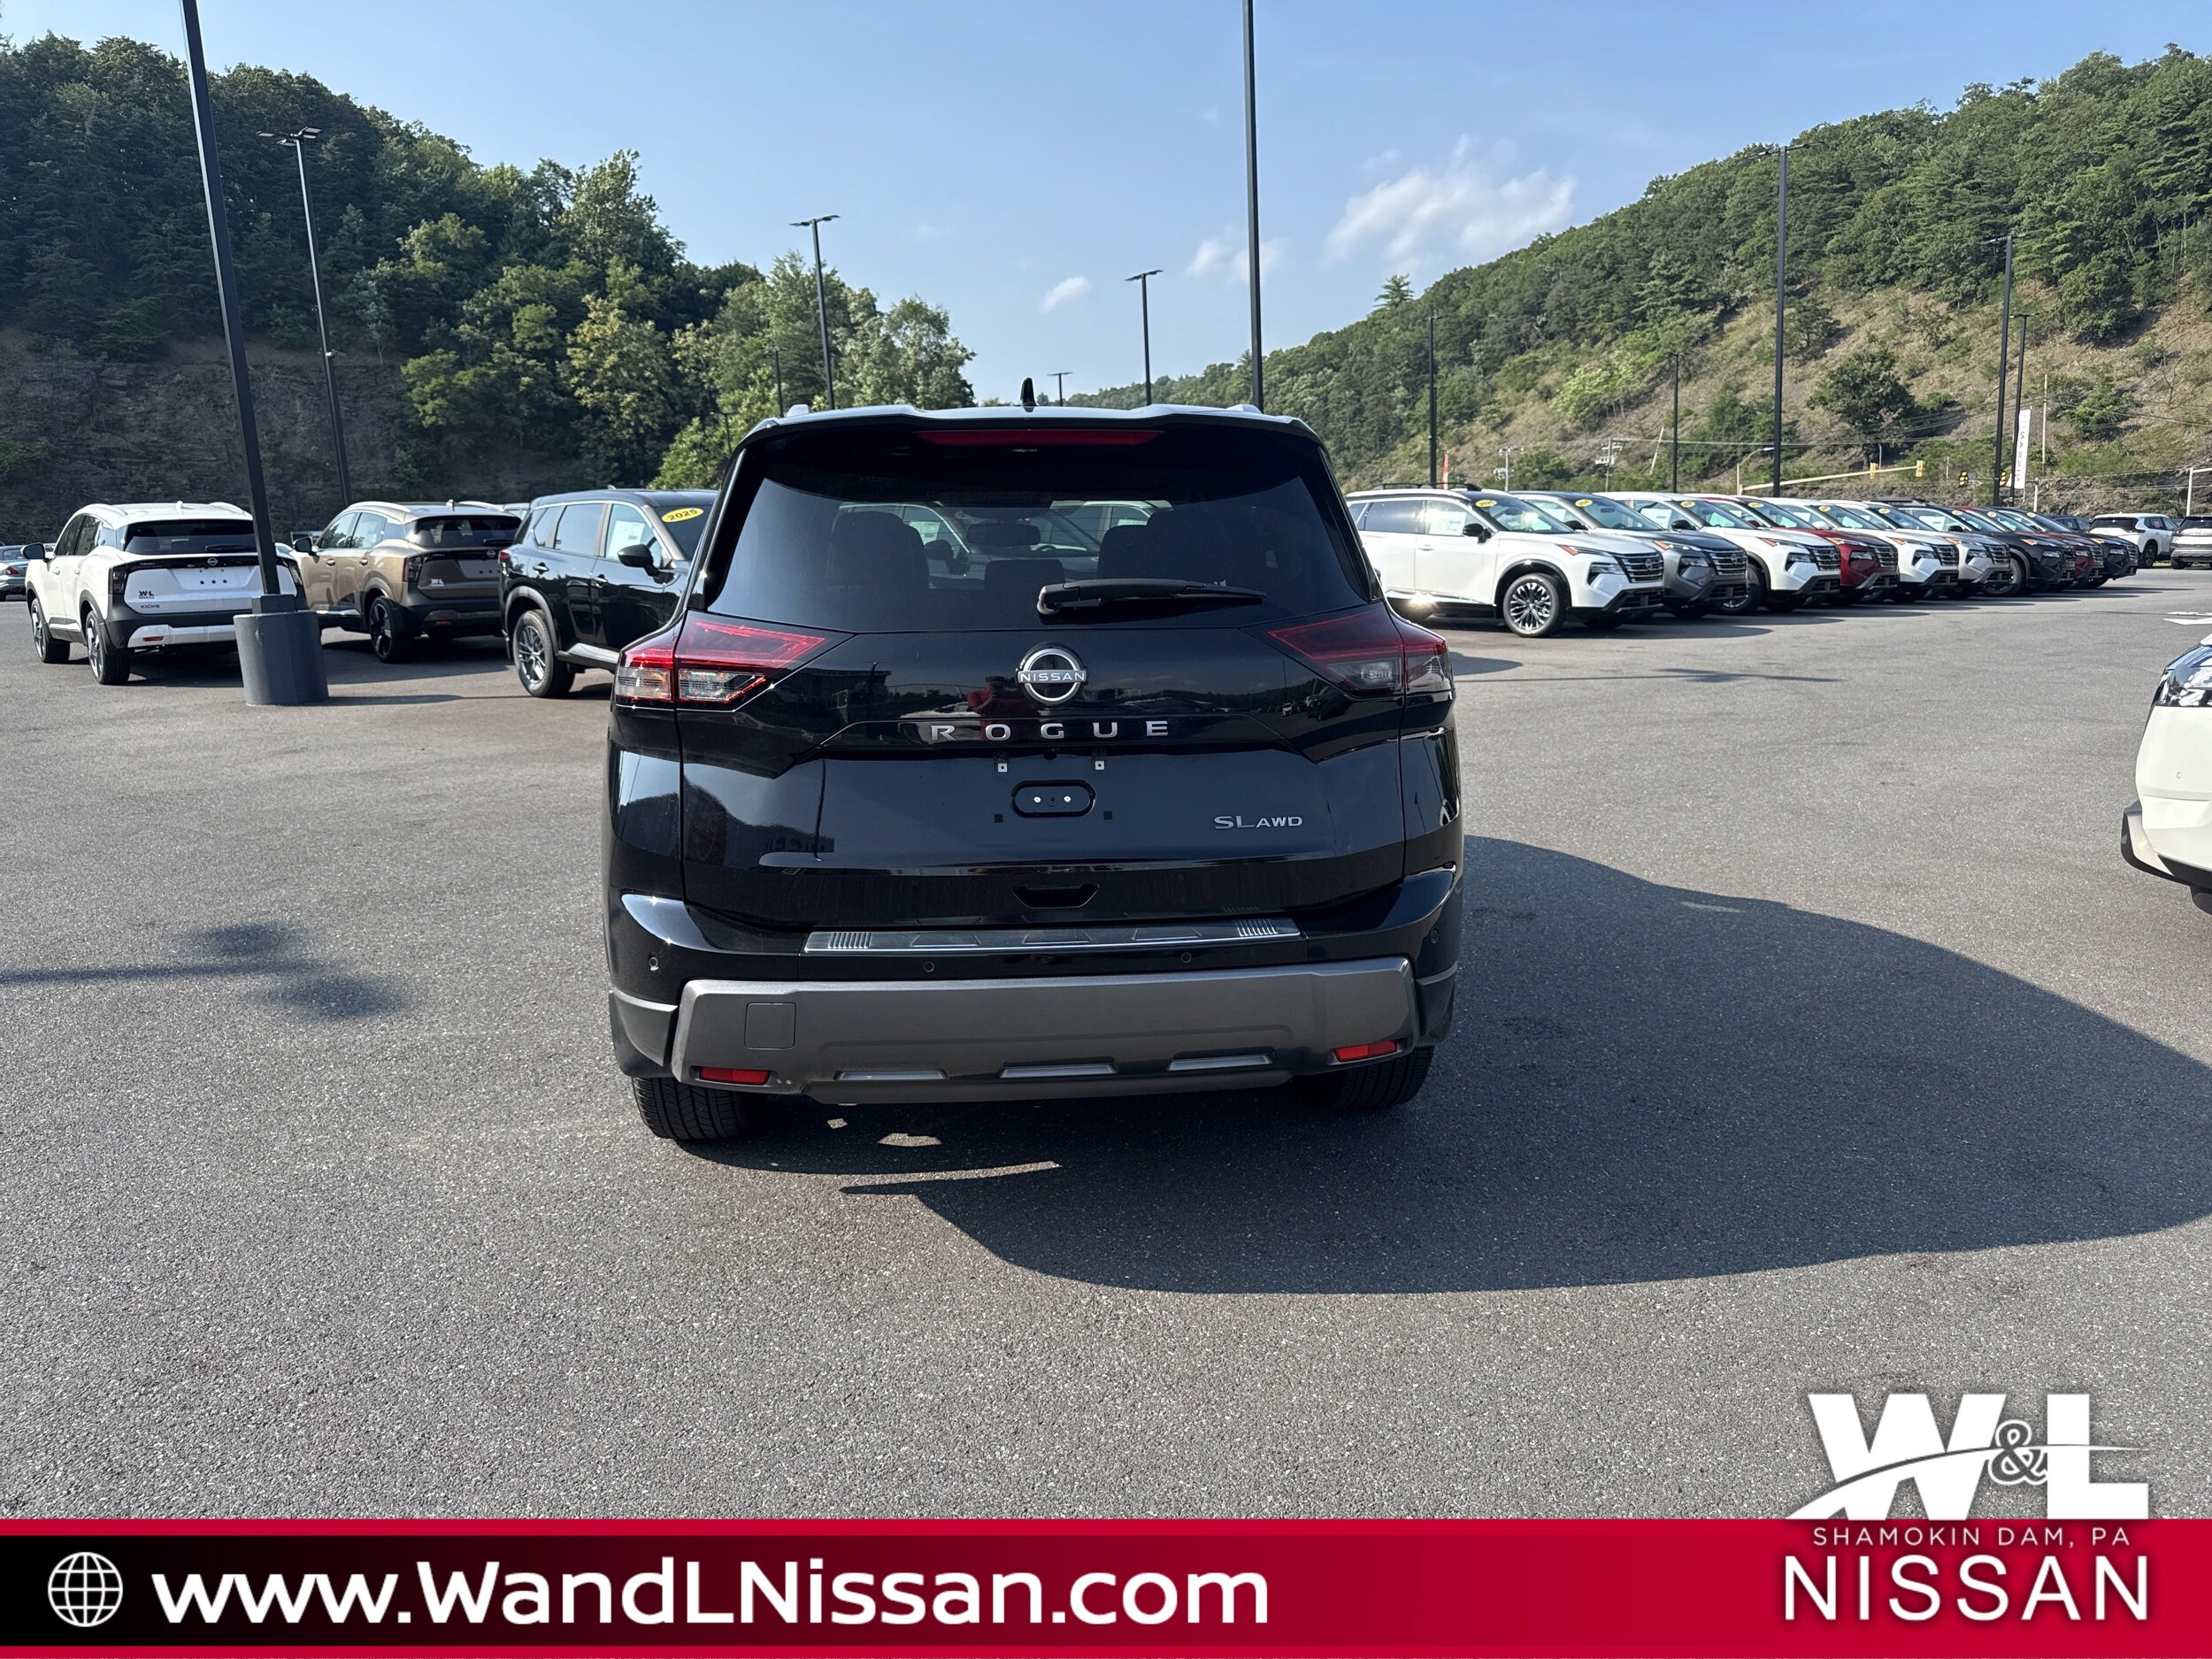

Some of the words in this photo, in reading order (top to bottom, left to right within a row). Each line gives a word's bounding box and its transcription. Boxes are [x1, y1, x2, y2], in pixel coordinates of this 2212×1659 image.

[667, 509, 698, 520] 2025
[1020, 672, 1085, 681] NISSAN
[931, 720, 1169, 741] ROGUE
